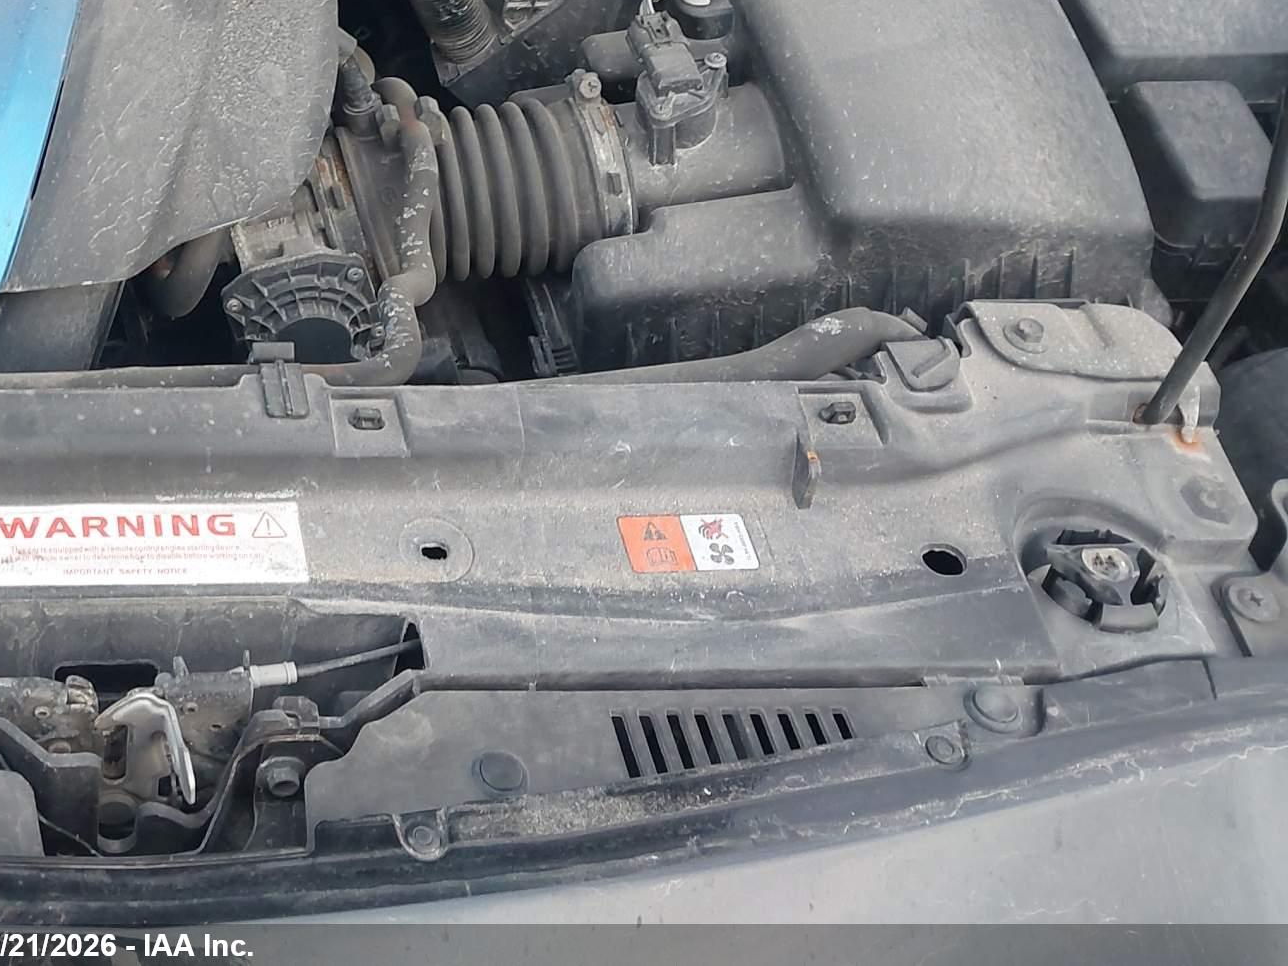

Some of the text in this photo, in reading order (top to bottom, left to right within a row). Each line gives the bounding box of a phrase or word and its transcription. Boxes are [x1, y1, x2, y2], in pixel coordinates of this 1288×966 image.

[49, 545, 83, 555] equipped
[84, 545, 99, 553] with
[107, 545, 133, 553] remote
[186, 545, 215, 553] starting
[63, 568, 114, 576] IMPORTANT
[157, 567, 188, 575] NOTICE
